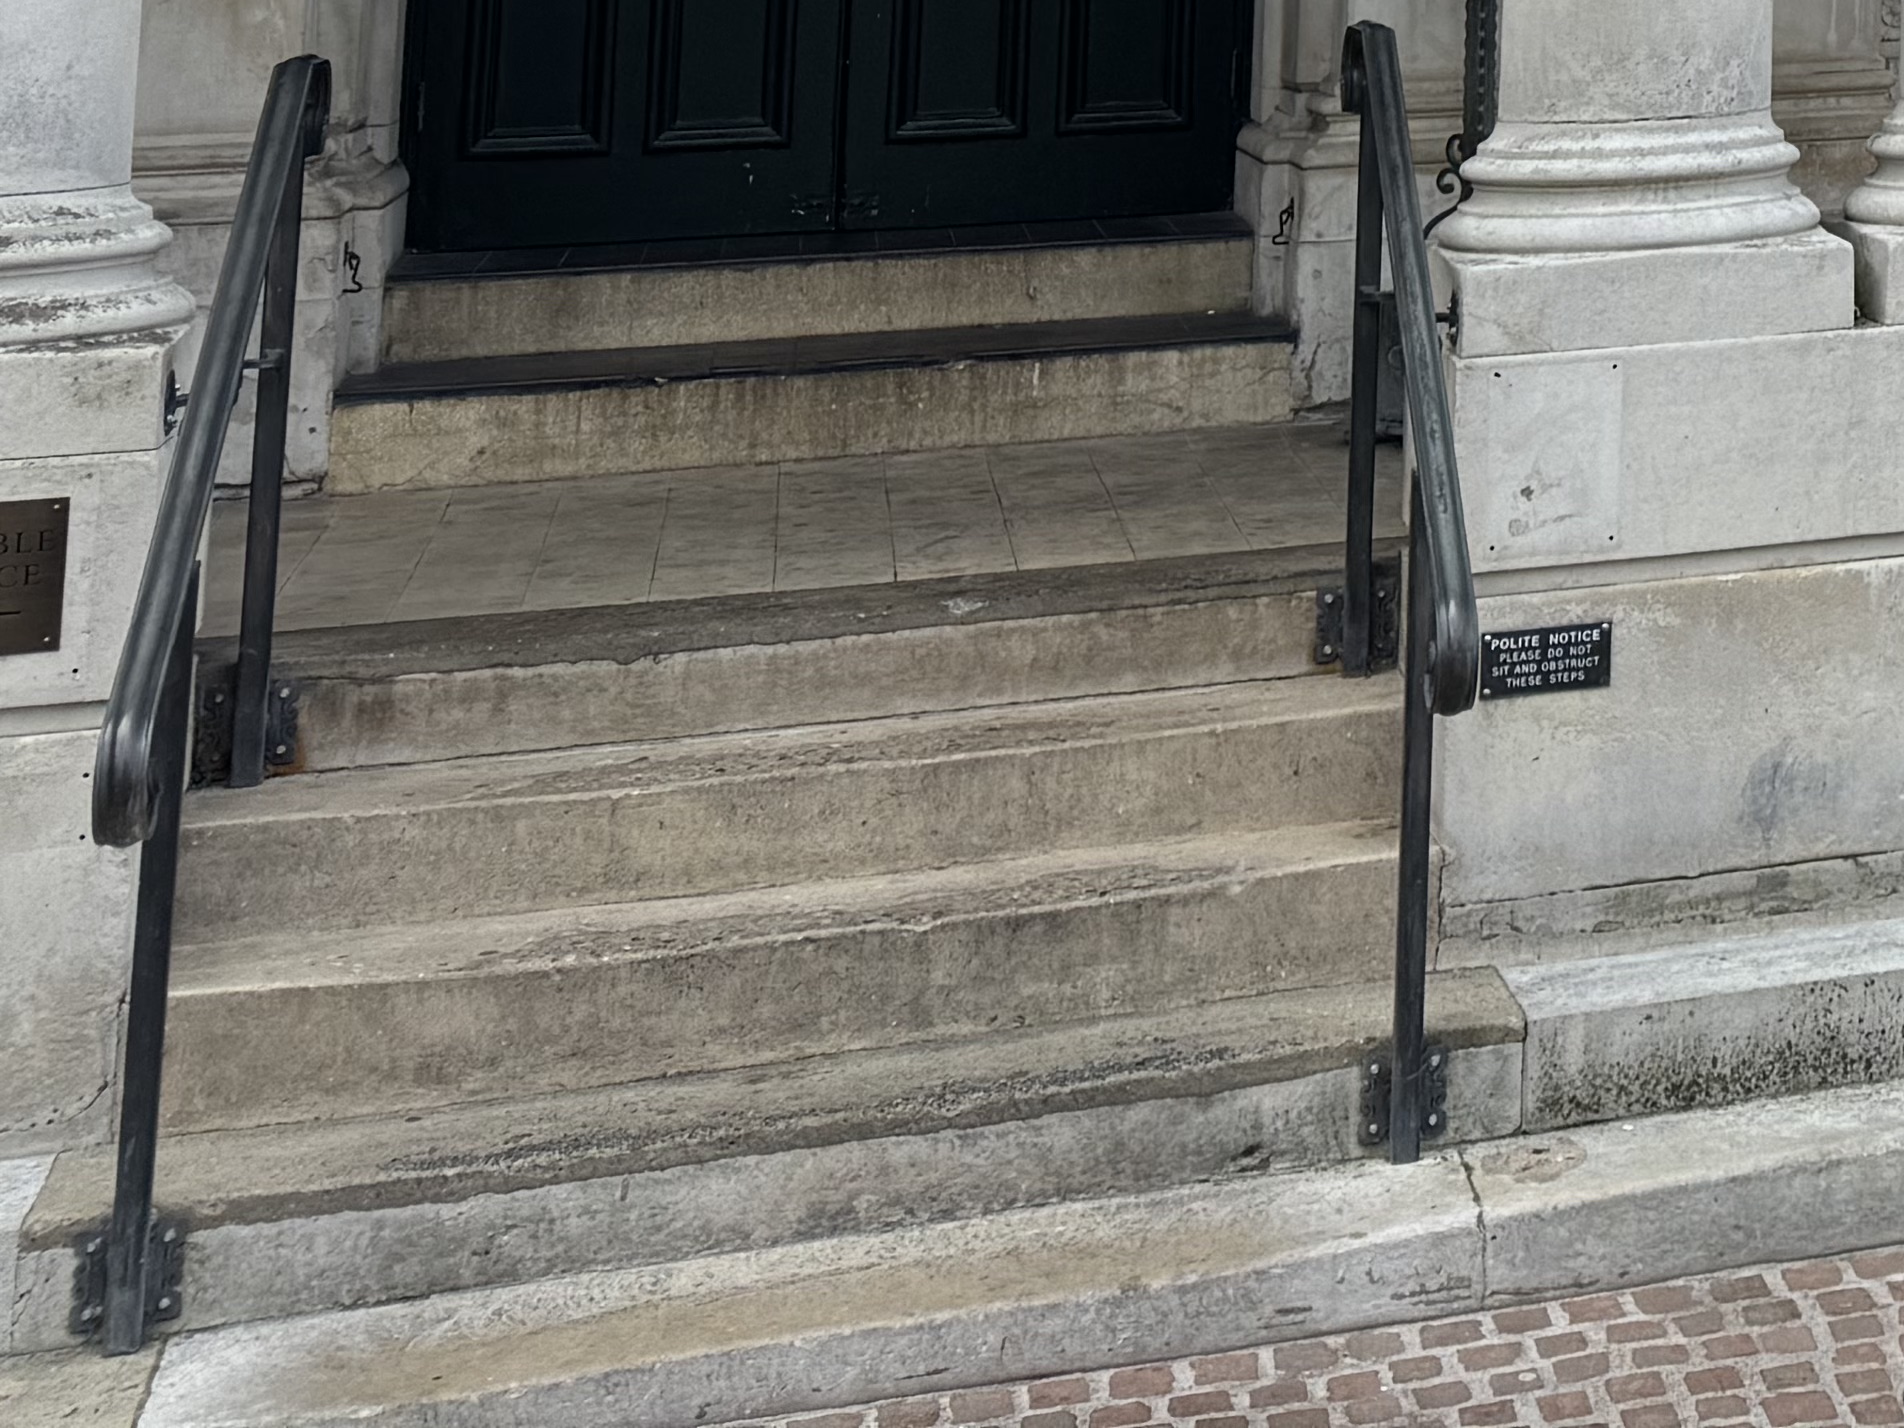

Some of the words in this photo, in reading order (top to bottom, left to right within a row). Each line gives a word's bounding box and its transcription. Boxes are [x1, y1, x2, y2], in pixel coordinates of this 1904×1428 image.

[1491, 635, 1540, 650] POLITE
[1549, 629, 1601, 645] NOTICE
[1500, 649, 1541, 663] PLEASE
[1548, 647, 1563, 659] DO
[1569, 644, 1592, 656] NOT
[1492, 665, 1510, 677] SIT
[1514, 663, 1537, 675] AND
[1541, 655, 1600, 672] OBSTRUCT
[1506, 675, 1542, 688] THESE
[1549, 670, 1585, 684] STEPS
